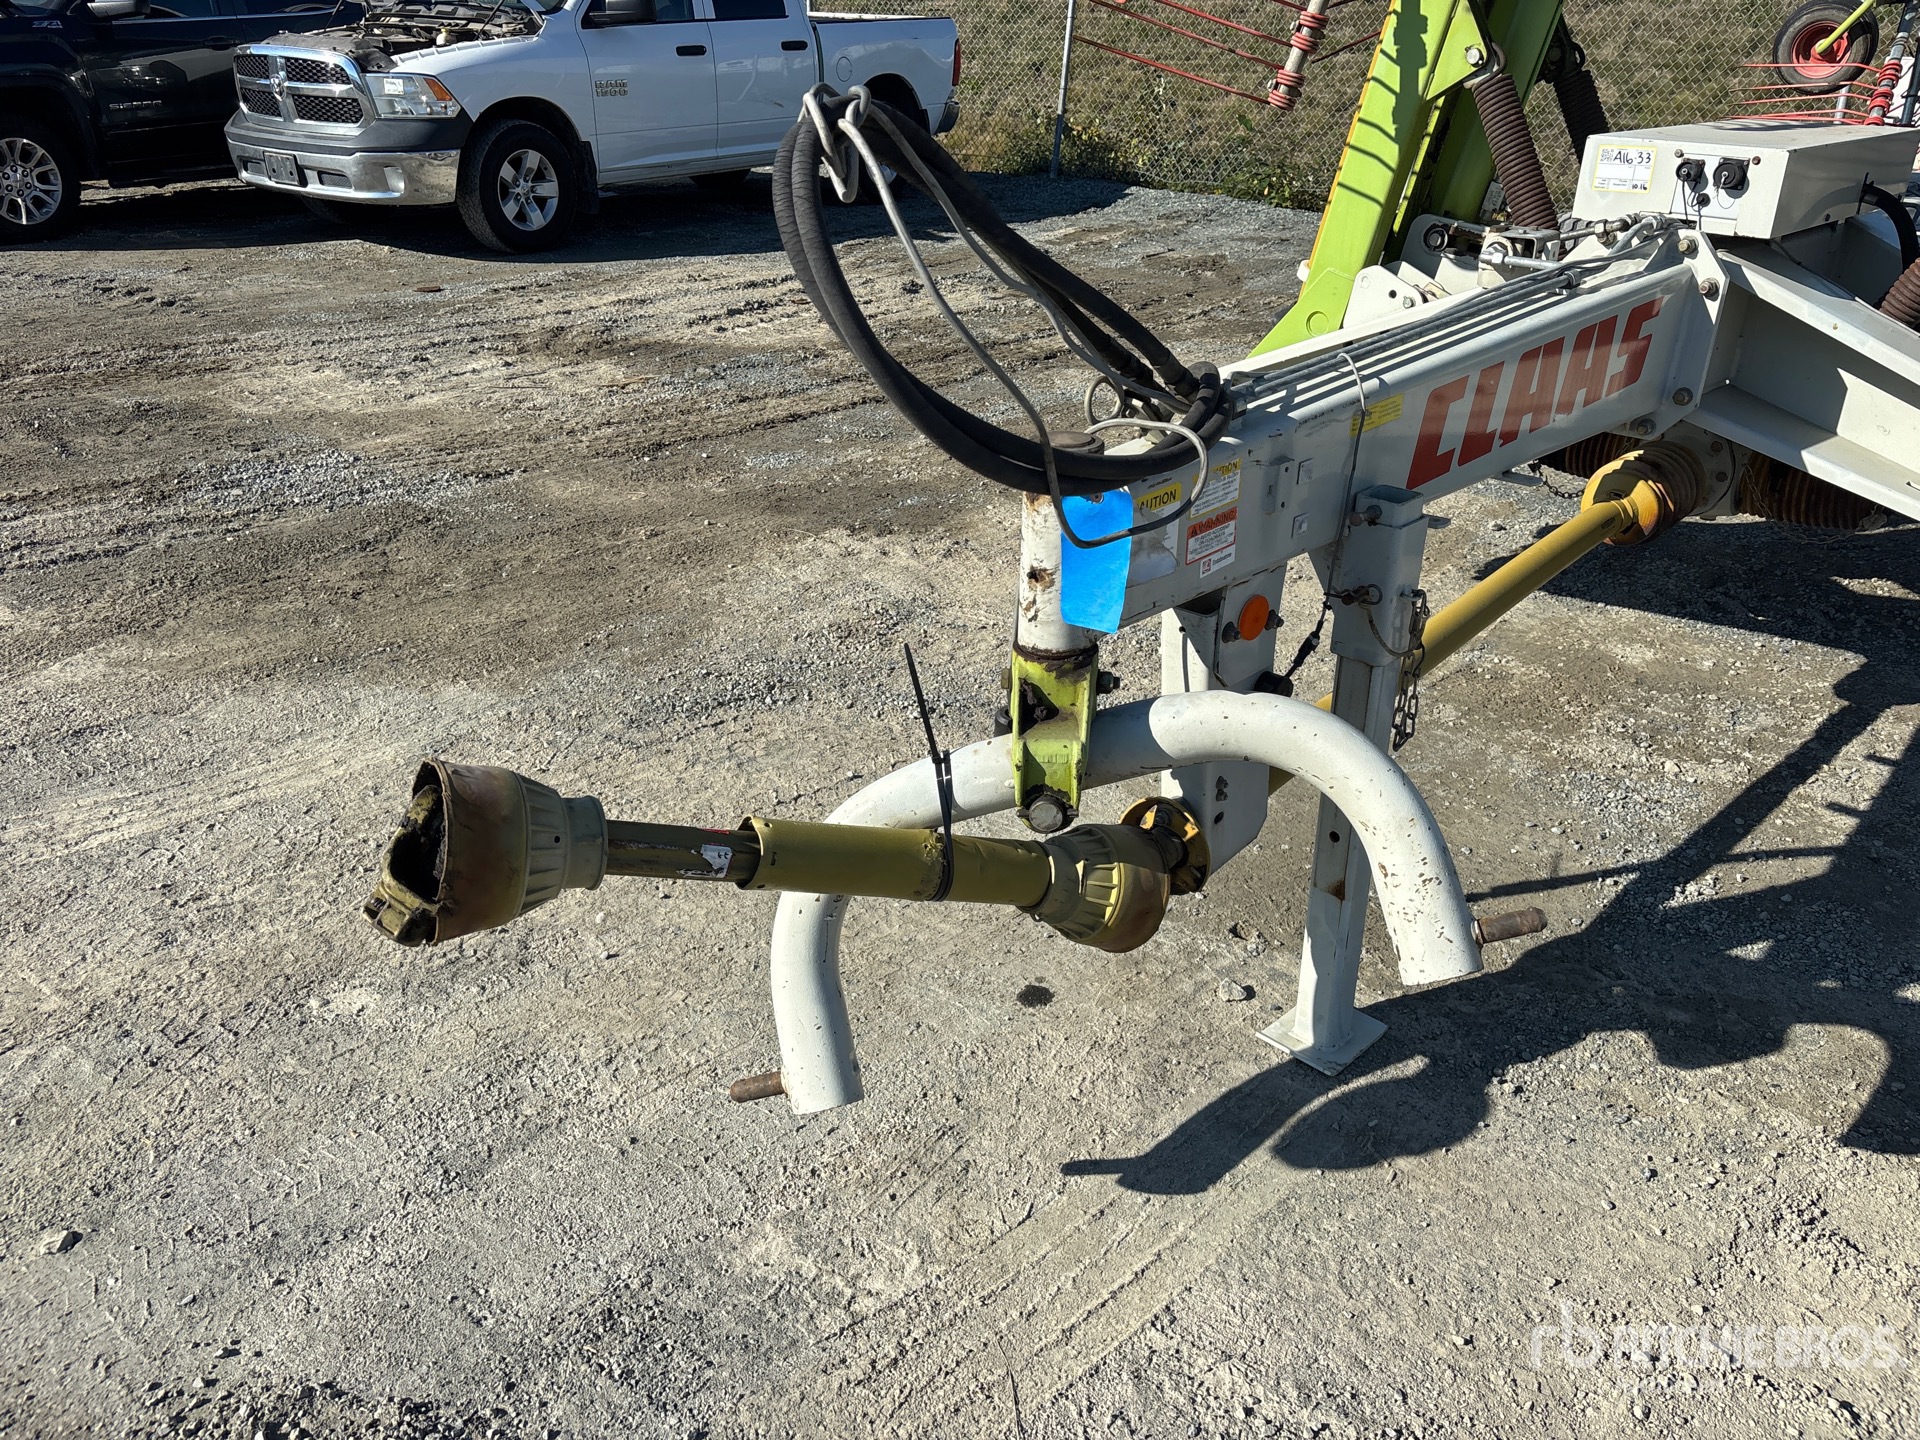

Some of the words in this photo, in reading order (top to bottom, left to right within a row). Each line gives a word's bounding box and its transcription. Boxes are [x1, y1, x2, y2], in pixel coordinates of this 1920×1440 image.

[595, 79, 628, 89] RAM
[596, 88, 628, 97] 1500
[1406, 296, 1664, 490] CLAAS
[1139, 489, 1177, 511] AUTION
[1199, 510, 1236, 531] WARNING
